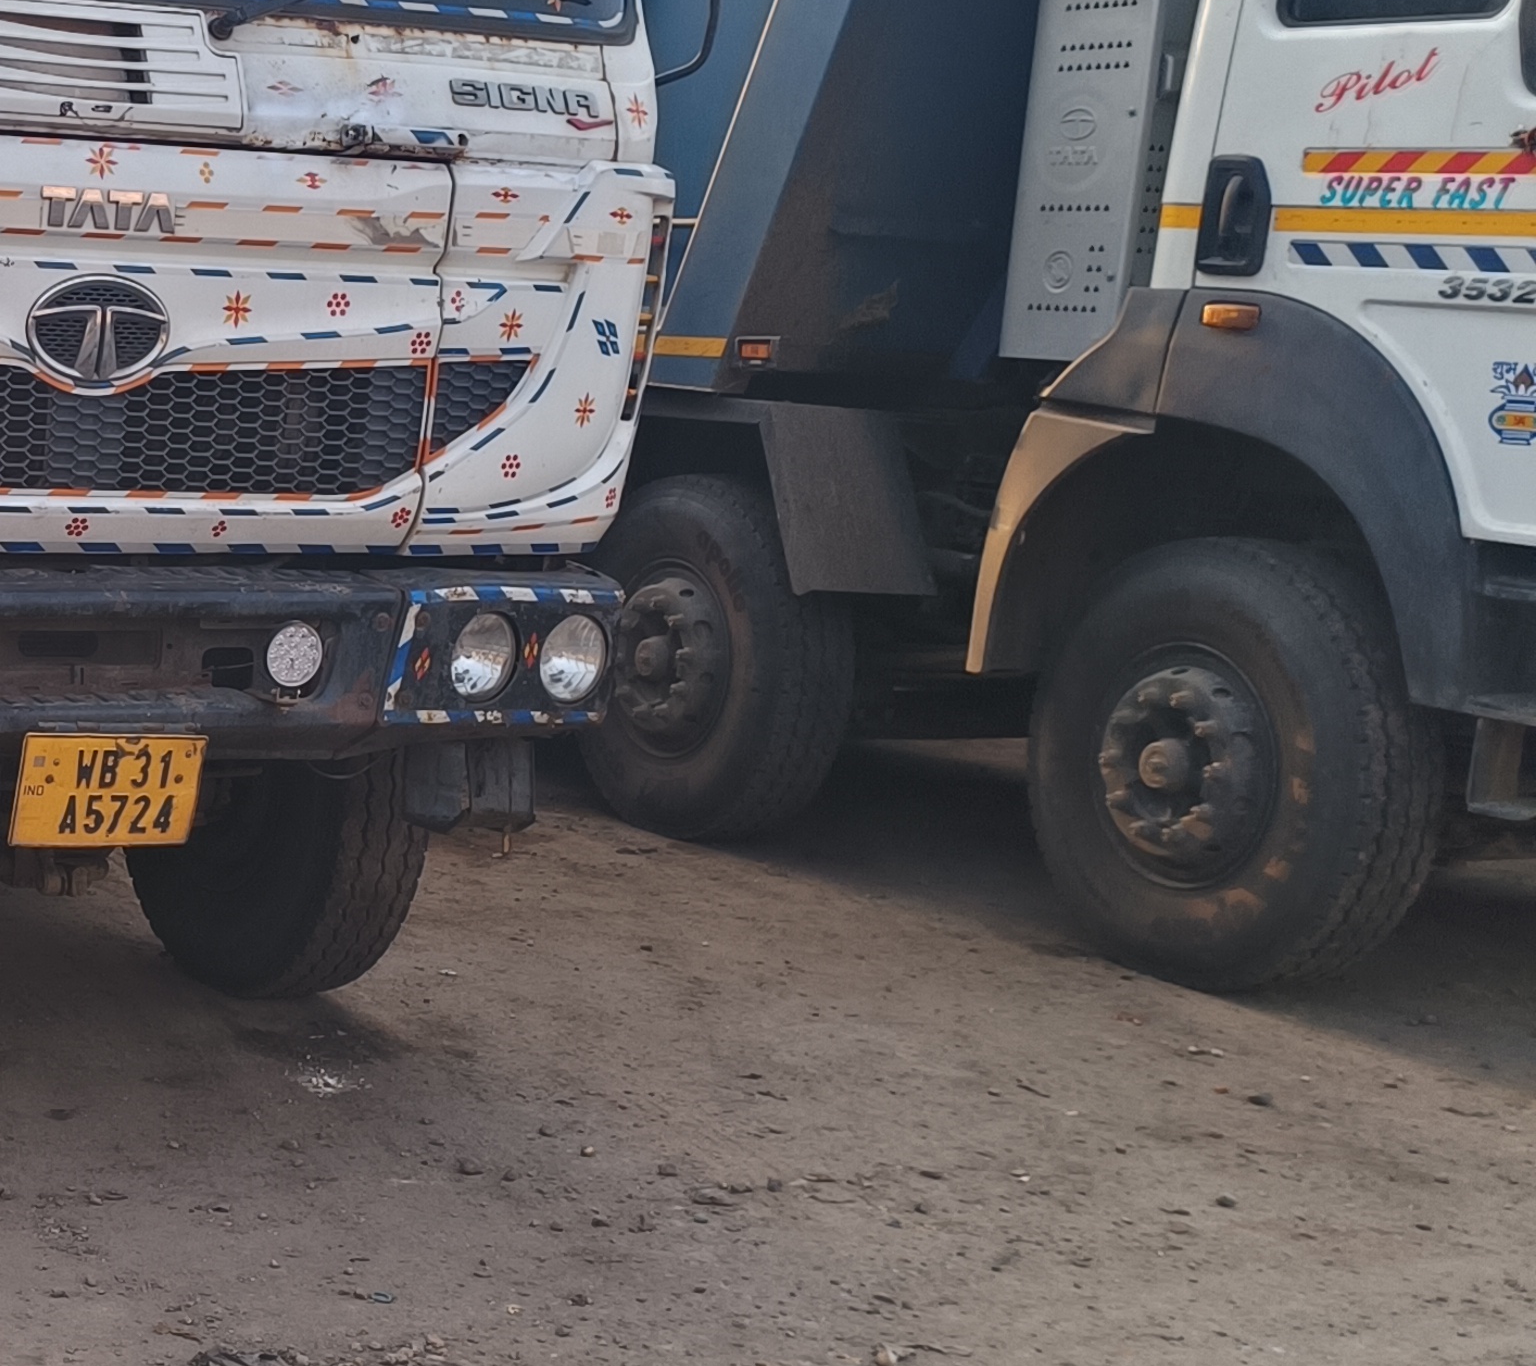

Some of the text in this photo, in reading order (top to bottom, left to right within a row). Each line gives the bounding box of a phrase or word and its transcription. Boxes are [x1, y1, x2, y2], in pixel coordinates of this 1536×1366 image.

[448, 77, 600, 119] SIGNA
[1314, 46, 1441, 114] Pilot
[40, 184, 177, 235] TATA
[1319, 174, 1517, 210] SUPER FAST
[75, 745, 175, 789] WB 31
[22, 784, 45, 797] IND
[58, 794, 176, 836] A5724
